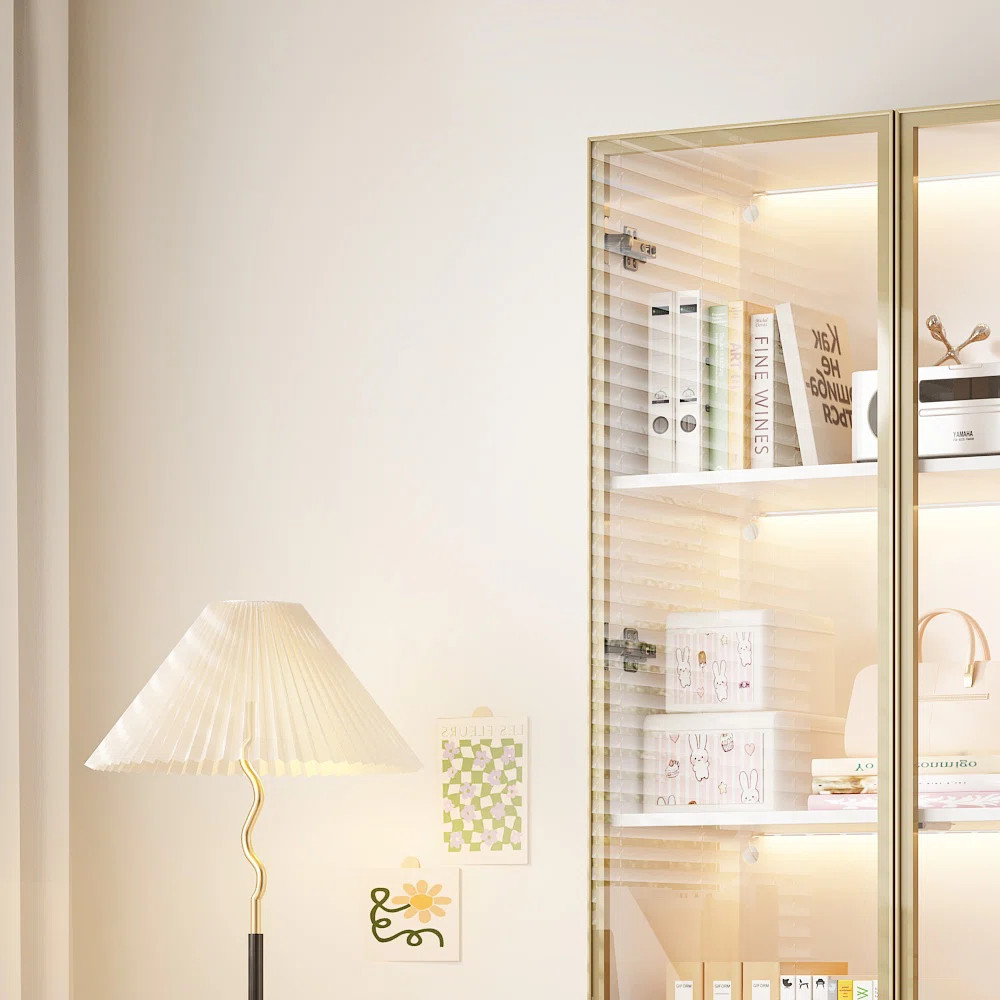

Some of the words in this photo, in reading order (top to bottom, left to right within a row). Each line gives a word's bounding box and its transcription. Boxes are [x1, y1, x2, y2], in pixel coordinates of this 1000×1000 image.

[754, 336, 769, 380] FINE
[754, 389, 769, 455] WINES
[952, 430, 974, 438] YAMAHA
